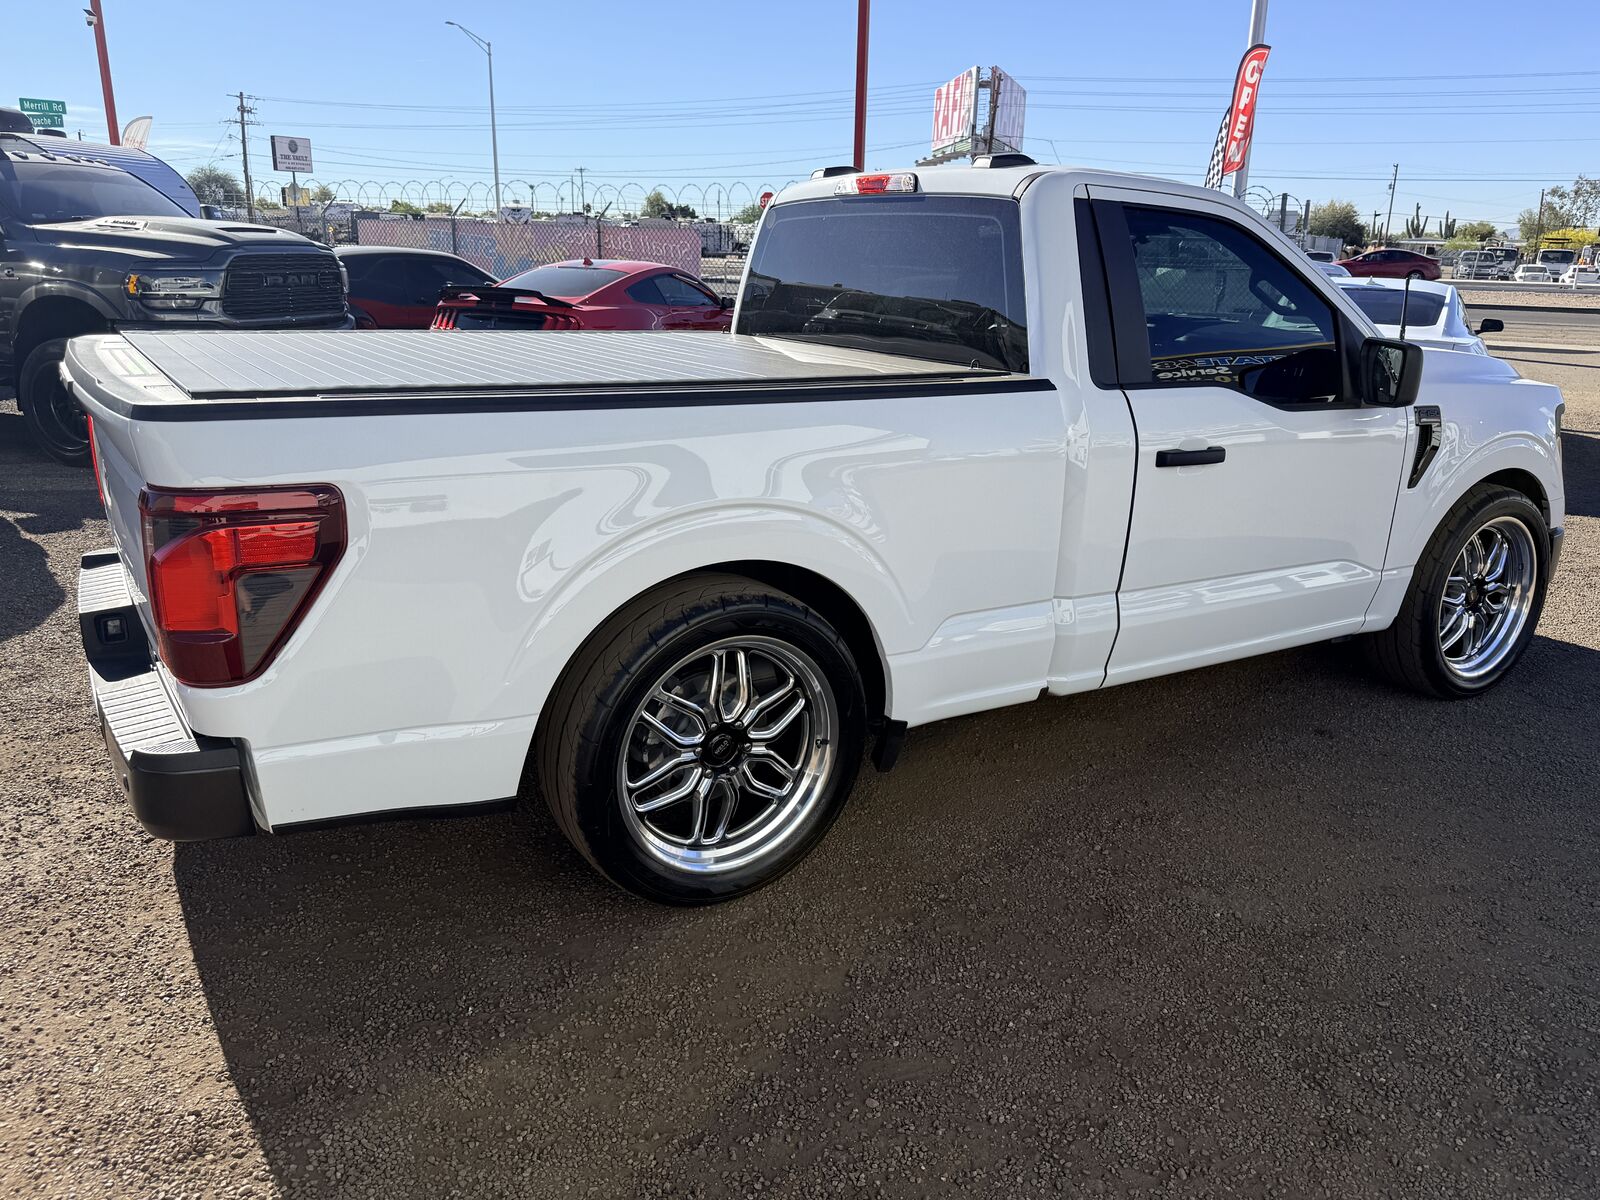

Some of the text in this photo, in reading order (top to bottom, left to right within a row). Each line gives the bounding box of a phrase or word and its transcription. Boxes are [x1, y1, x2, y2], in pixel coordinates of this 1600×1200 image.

[23, 100, 63, 112] Merrill Rd
[933, 73, 966, 141] RAFI
[1228, 60, 1262, 162] OPEN
[54, 116, 61, 125] Tr
[266, 274, 316, 286] RAM
